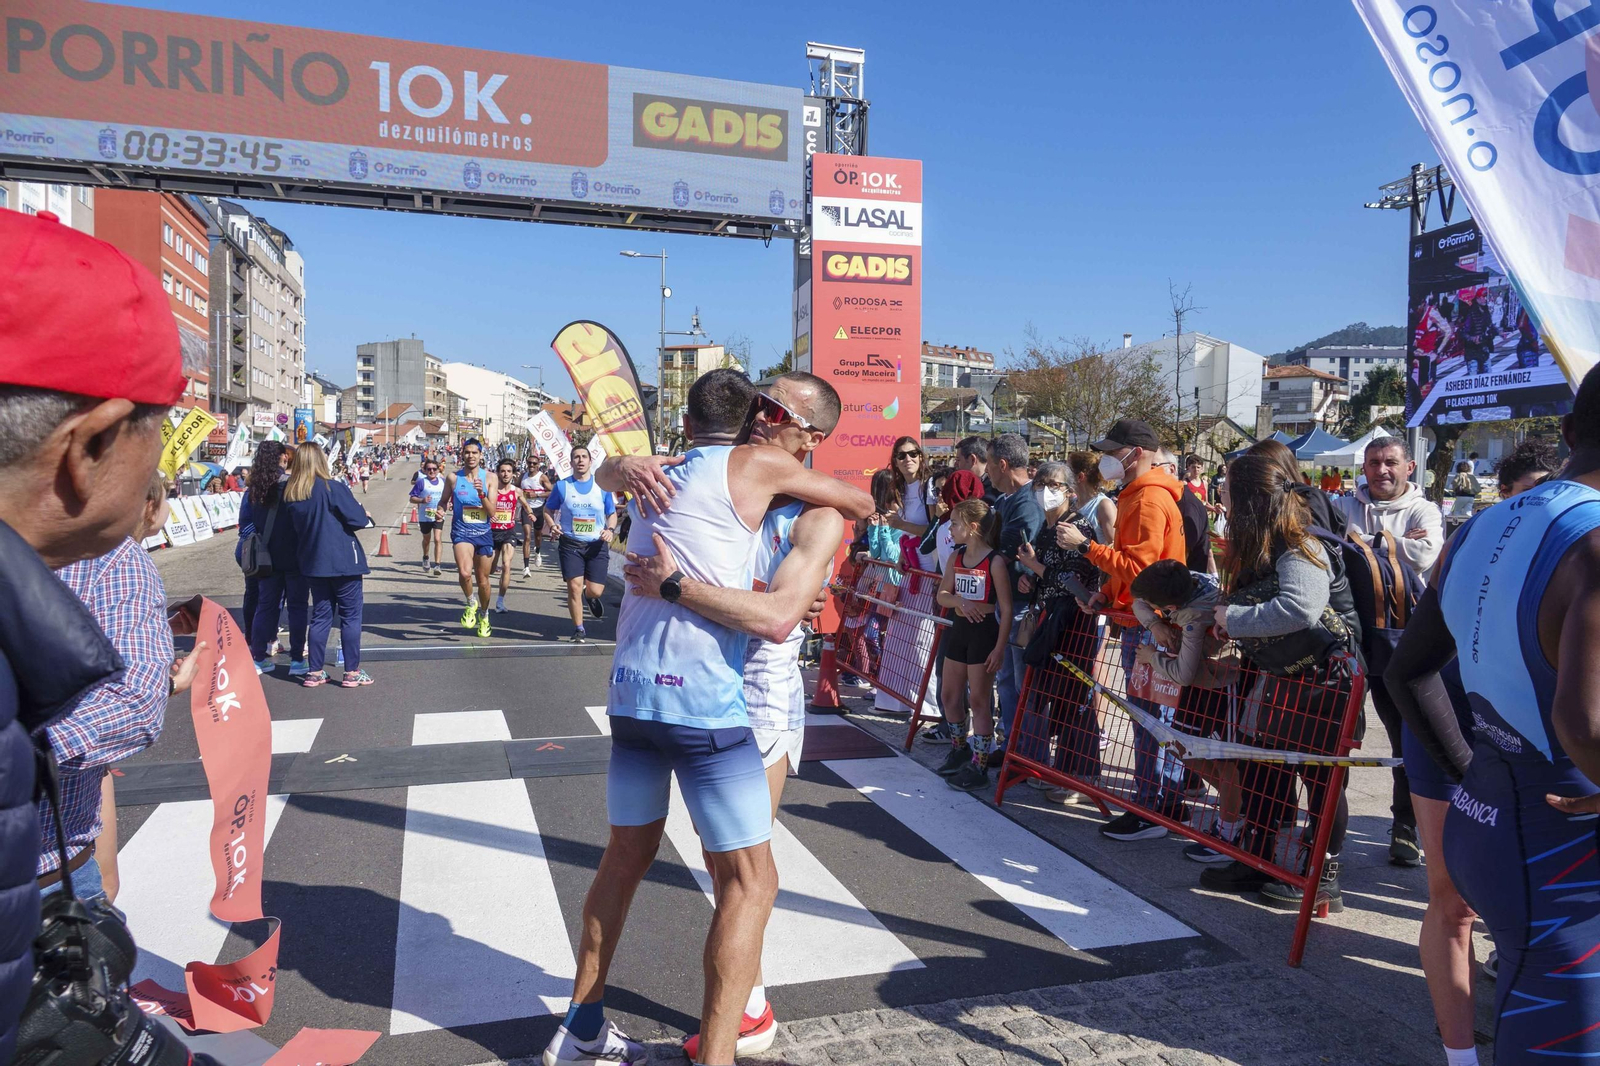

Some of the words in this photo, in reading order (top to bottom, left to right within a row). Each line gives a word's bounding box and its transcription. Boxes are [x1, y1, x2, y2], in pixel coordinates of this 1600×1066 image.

[6, 17, 350, 106] PORRIÑO
[640, 101, 783, 149] GADIS
[379, 120, 533, 152] dezquilómetros
[122, 130, 283, 172] 00:33:45
[386, 163, 427, 177] Porriño
[499, 173, 537, 187] Porriño
[604, 184, 641, 196] Porriño
[704, 191, 739, 205] Porriño
[844, 206, 913, 231] LASAL
[888, 230, 914, 238] cocinas
[827, 254, 911, 284] GADIS
[844, 297, 888, 307] RODOSA
[850, 325, 902, 336] ELECPOR
[839, 359, 865, 367] Grupo
[833, 368, 860, 377] Godoy
[861, 369, 896, 377] Maceira
[1445, 378, 1474, 393] ASHEBER
[1474, 373, 1489, 388] DÍAZ
[1490, 371, 1532, 387] FERNÁNDEZ
[843, 403, 884, 412] aturGas
[1451, 395, 1486, 407] CLASIFICADO
[170, 414, 206, 456] ELECPOR
[470, 512, 480, 520] 65
[575, 524, 593, 533] 2278
[1490, 515, 1522, 564] CELTA
[956, 577, 977, 594] 3015
[1152, 680, 1179, 697] orriño
[1451, 784, 1499, 827] ABANCA
